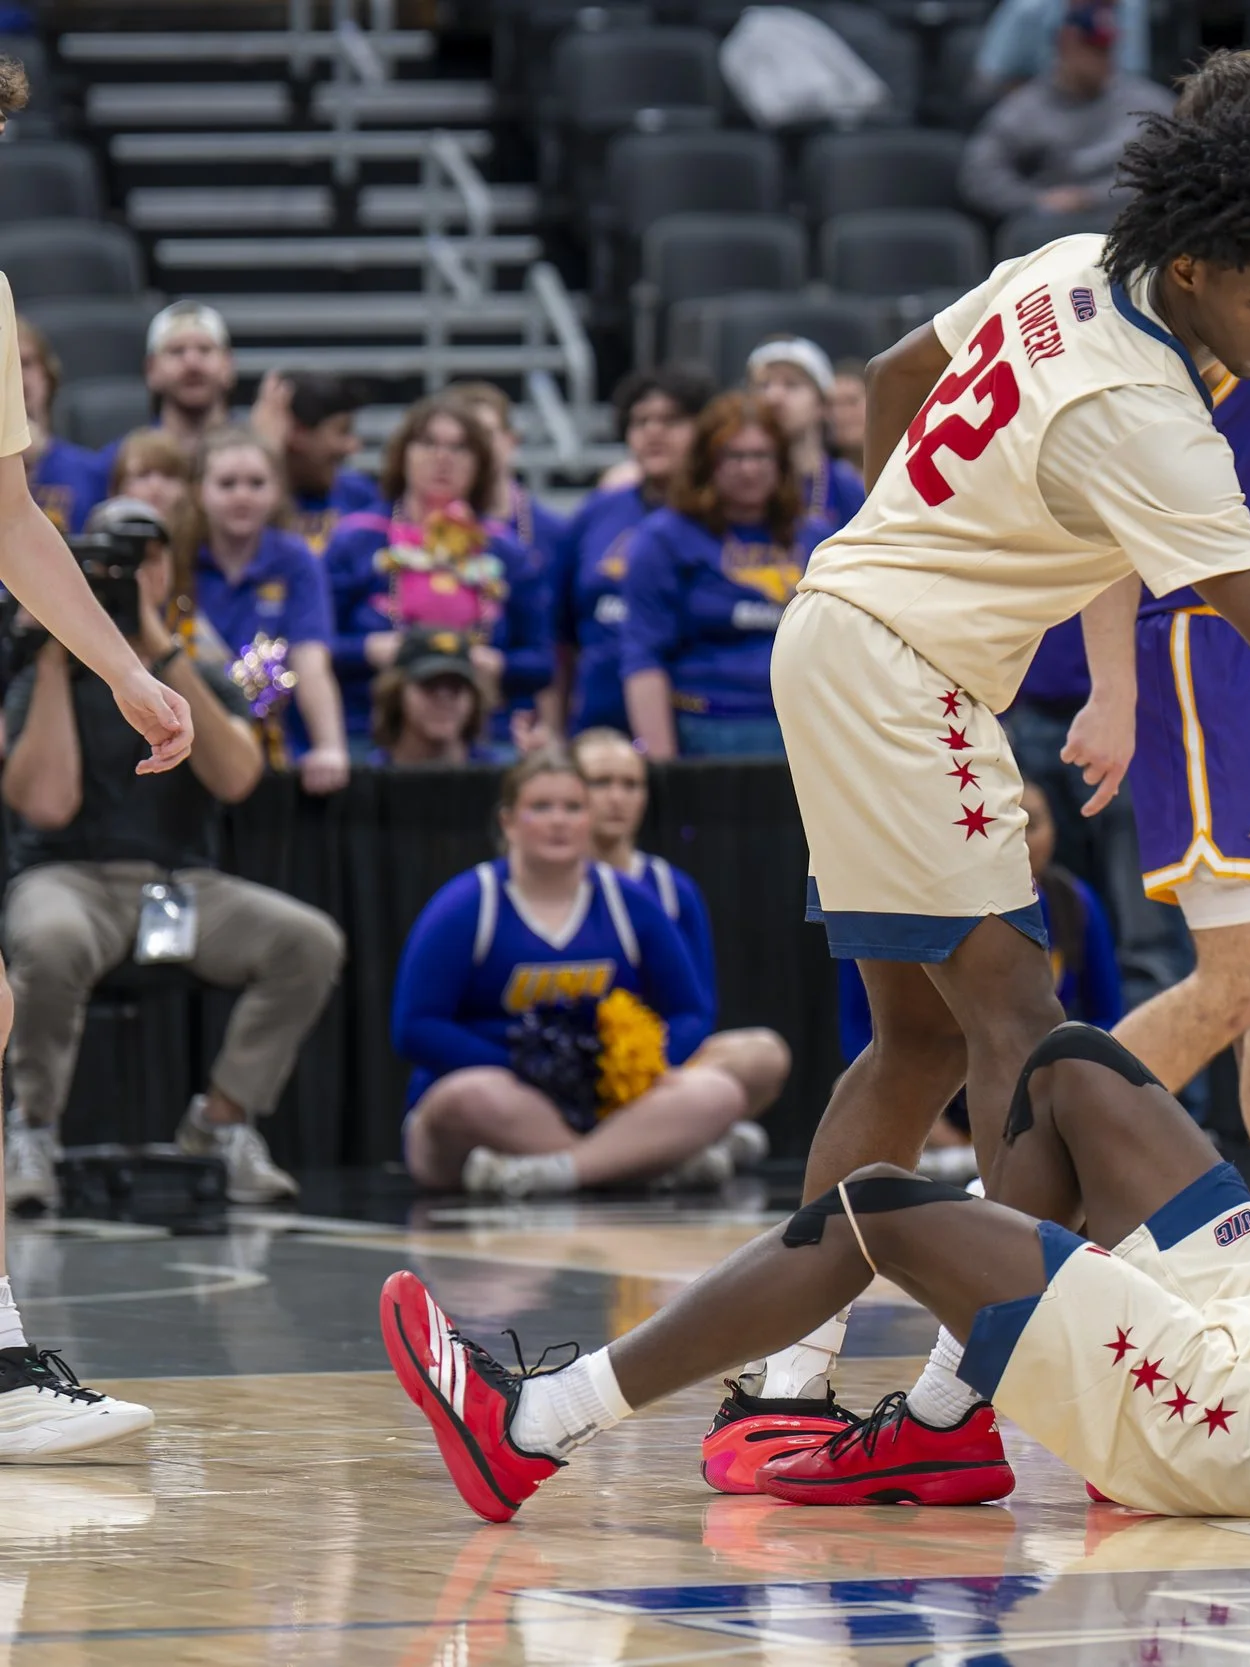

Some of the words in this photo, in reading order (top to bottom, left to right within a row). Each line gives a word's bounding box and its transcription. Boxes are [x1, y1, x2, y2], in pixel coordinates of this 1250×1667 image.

[1015, 283, 1065, 368] LOWERY
[1069, 286, 1097, 322] UIC
[905, 312, 1020, 507] 22
